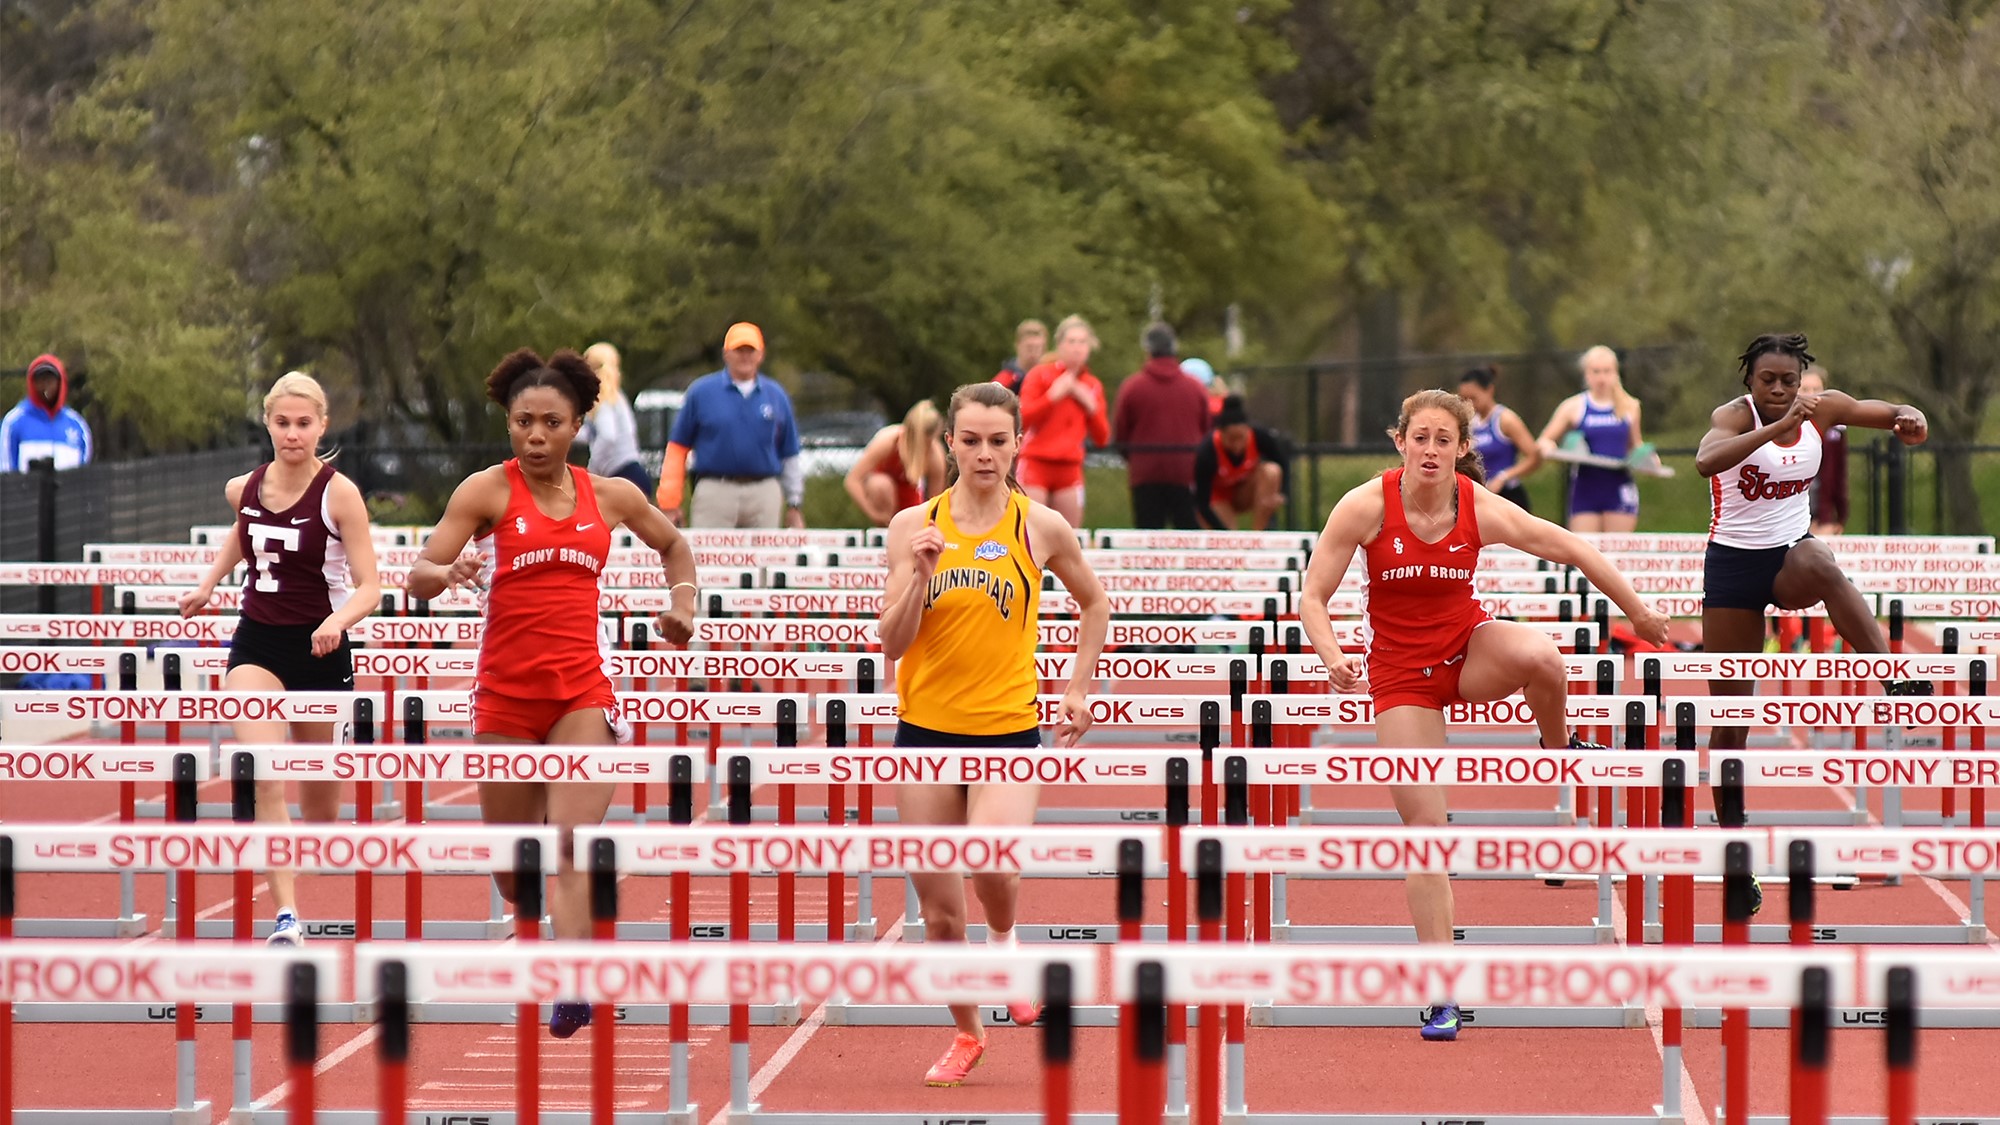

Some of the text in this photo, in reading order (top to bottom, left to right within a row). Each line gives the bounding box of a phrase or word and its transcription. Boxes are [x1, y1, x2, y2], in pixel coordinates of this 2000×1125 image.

[975, 544, 1007, 558] MAAC
[1659, 540, 1708, 551] BROO
[1885, 542, 1943, 553] BROOK
[140, 552, 197, 563] STONY
[248, 523, 300, 593] F
[387, 552, 420, 564] STO
[512, 549, 600, 573] STONY BROOK
[631, 553, 662, 565] STO
[1120, 556, 1178, 568] STONY
[1617, 559, 1674, 571] STONY
[1861, 560, 1917, 572] STONY
[1924, 560, 1985, 572] BROOK
[28, 569, 90, 584] STONY
[98, 569, 166, 584] BROOK
[630, 573, 667, 586] BRO
[1381, 566, 1470, 581] STONY BROOK
[1101, 576, 1160, 590] STONY
[1167, 576, 1236, 590] BROOK
[1633, 577, 1695, 592] STONY
[1896, 578, 1959, 592] STONY
[1966, 578, 2000, 592] BRO
[633, 598, 664, 606] UCS
[732, 595, 884, 612] UCS STONY BRO
[1142, 597, 1216, 613] BROOK
[1517, 603, 1548, 611] UCS
[1914, 600, 2000, 616] UCS STON
[7, 624, 41, 632] UCS
[48, 620, 125, 638] STONY
[133, 621, 217, 639] BROOK
[372, 623, 449, 640] STONY
[699, 624, 868, 642] STONY BROOK
[1113, 626, 1197, 644] BROOK
[1202, 631, 1237, 640] UCS
[0, 652, 105, 672] OOK UCS
[354, 655, 474, 675] ROOK UCS
[610, 656, 843, 677] STONY BROOK UCS
[1095, 659, 1216, 679] ROOK UCS
[1300, 665, 1330, 674] UC
[1673, 658, 1955, 679] UCS STONY BROOK UCS
[15, 697, 338, 720] UCS STONY BROOK UCS
[438, 703, 468, 713] UC
[717, 705, 761, 715] UCS
[1140, 707, 1184, 717] UCS
[1286, 706, 1331, 716] UCS
[1450, 701, 1536, 723] BROO
[1565, 708, 1610, 718] UCS
[1710, 702, 1983, 725] UCS STONY BROOK
[0, 752, 154, 779] ROOK UCS
[272, 752, 650, 780] UCS STONY BROOK UCS
[768, 756, 1147, 783] UCS STONY BROOK UCS
[1265, 756, 1644, 784] UCS STONY BROOK UCS
[1762, 765, 1814, 777] UCS
[1822, 758, 1941, 785] STONY
[1120, 811, 1159, 821] UCS
[35, 835, 491, 869] UCS STONY BROOK UCS
[637, 837, 1093, 870] UCS STONY BROOK UCS
[1244, 838, 1702, 872] UCS STONY BROOK UCS
[1837, 840, 2000, 872] UCS STO
[308, 924, 355, 936] UCS
[688, 926, 724, 938] CS
[1049, 929, 1097, 940] UCS
[0, 959, 253, 998] ROOK UCS
[433, 959, 1011, 1000] UCS STONY BROOK UCS
[1191, 960, 1771, 1003] UCS STONY BROOK UCS
[1946, 976, 2000, 994] UC
